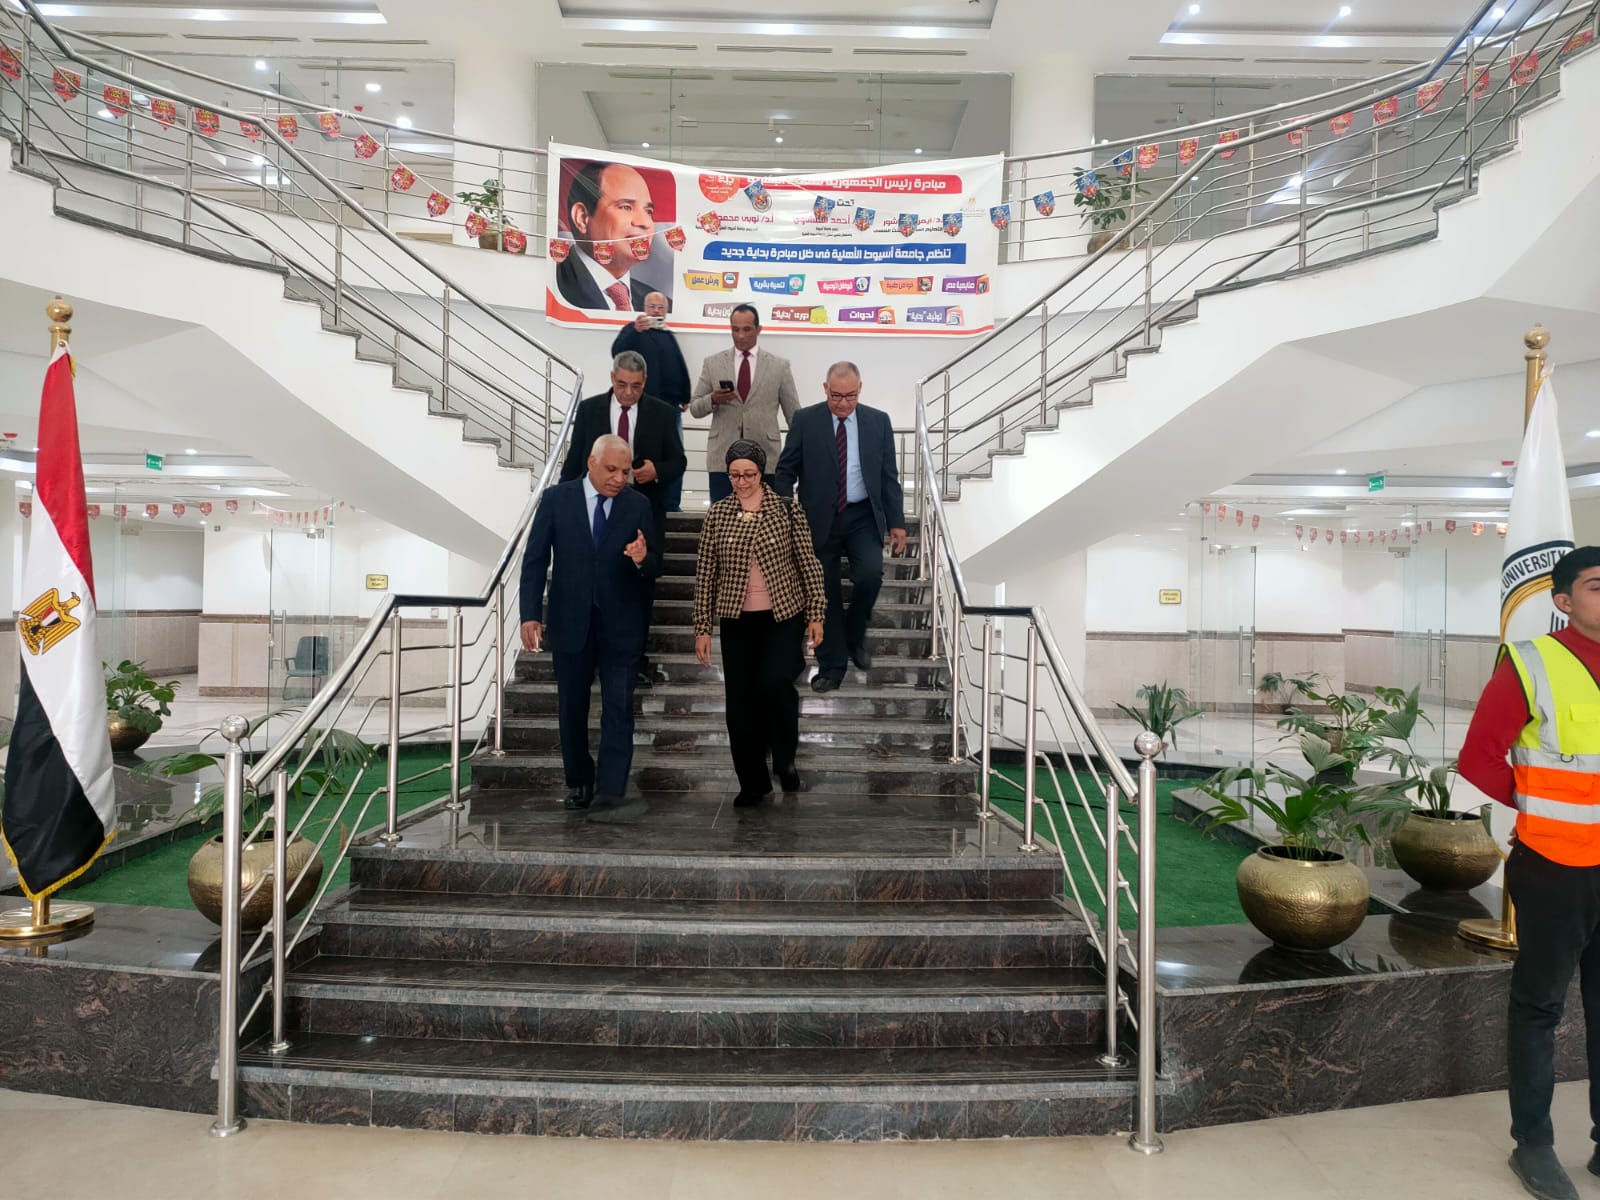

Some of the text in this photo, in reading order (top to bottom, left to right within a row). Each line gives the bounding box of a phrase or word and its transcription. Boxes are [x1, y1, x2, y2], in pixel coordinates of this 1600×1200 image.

[884, 178, 912, 191] رئيس
[914, 178, 946, 191] مبادرة
[836, 199, 855, 207] تحت
[830, 214, 851, 225] أحمد
[720, 247, 745, 259] جديد
[746, 246, 769, 260] بداية
[770, 247, 798, 261] مبادرة
[798, 248, 814, 260] ظل
[832, 246, 863, 262] الأهلية
[864, 246, 894, 262] أسيوط
[895, 248, 925, 262] جامعة
[926, 248, 952, 262] تنظم
[691, 275, 720, 286] ورش عمل
[849, 310, 874, 320] ندوات
